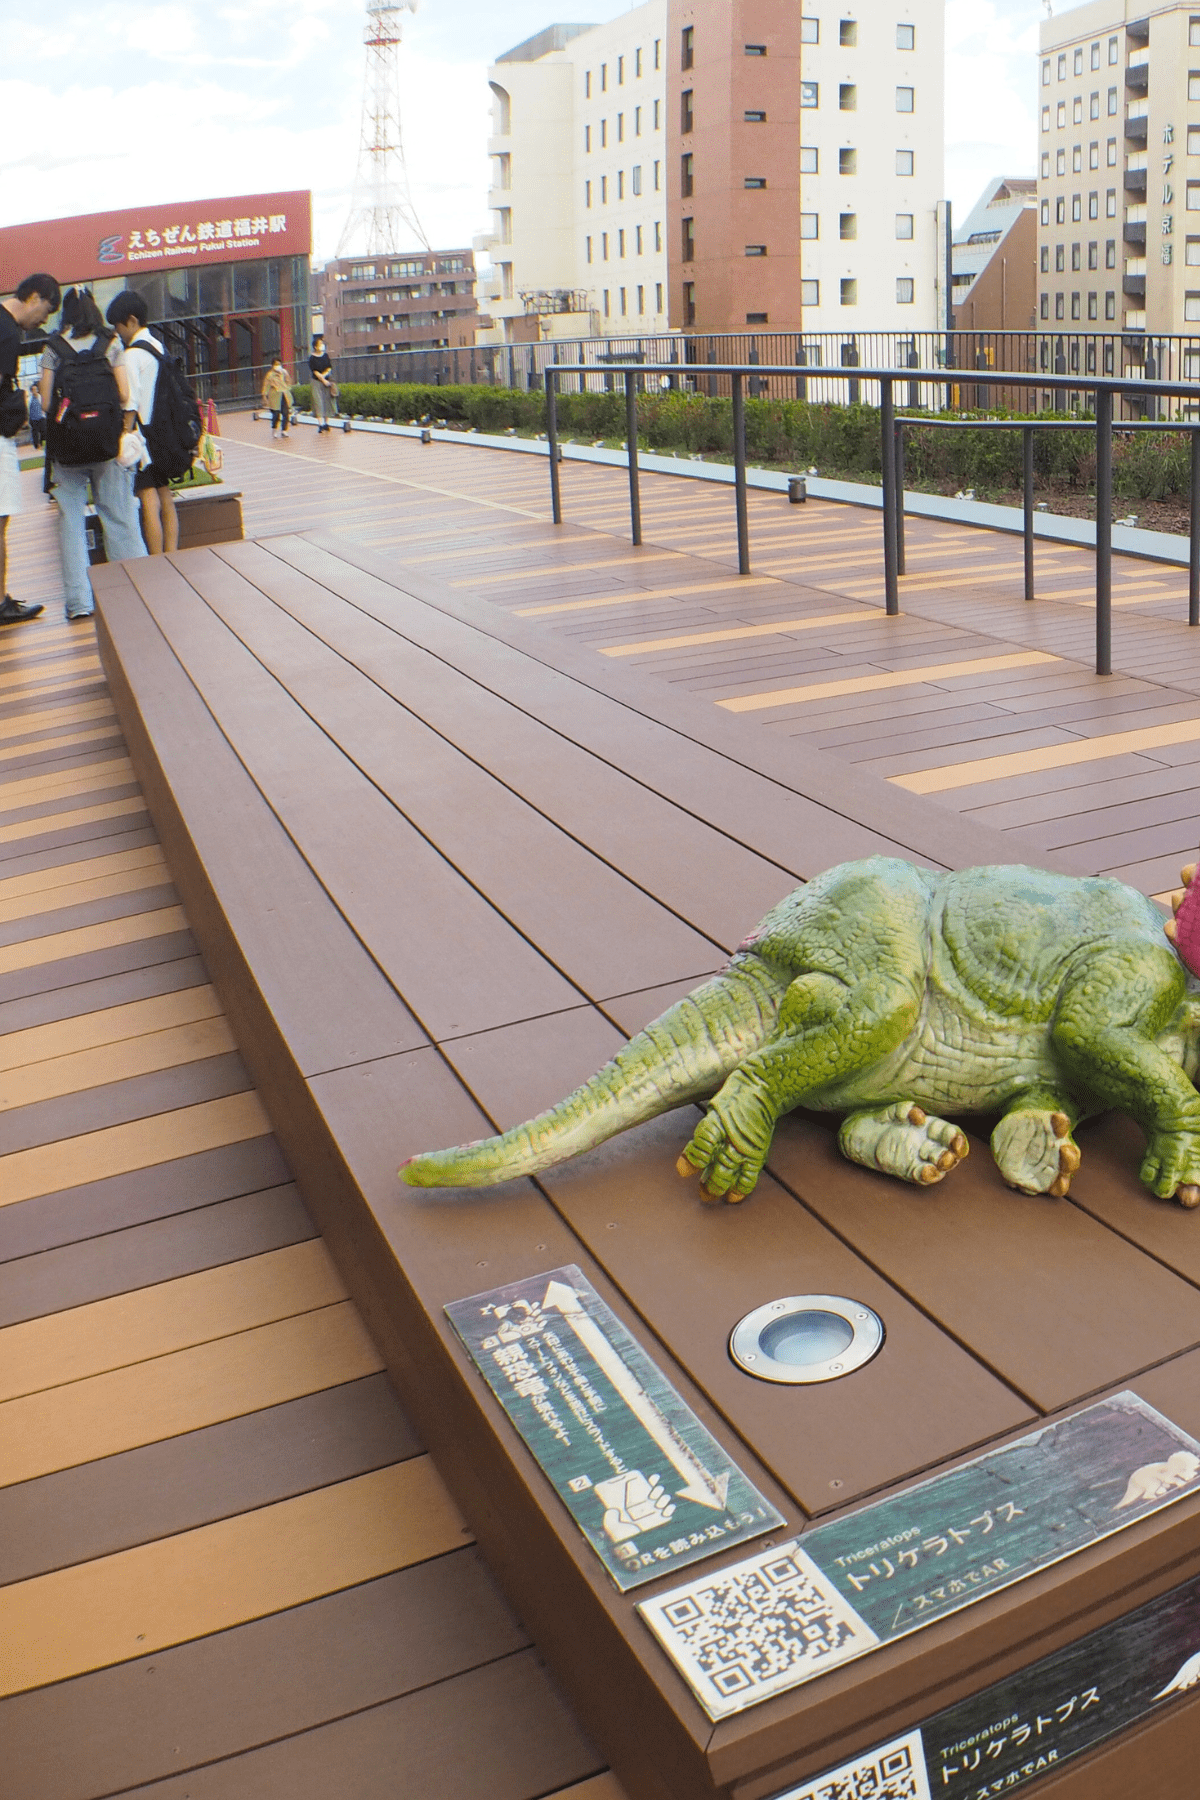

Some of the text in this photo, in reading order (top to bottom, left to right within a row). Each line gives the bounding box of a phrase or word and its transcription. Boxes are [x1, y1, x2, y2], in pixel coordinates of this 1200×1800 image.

[127, 238, 260, 261] Echizen Railway Fukui Station
[128, 214, 287, 249] えちぜん鉄道福井駅
[834, 1525, 922, 1569] Triceratops
[845, 1501, 1026, 1592] トリケラトプス
[912, 1557, 1011, 1610] スマホでAR
[939, 1713, 1019, 1759] Triceratops
[941, 1685, 1101, 1785] トリケラトプス
[976, 1749, 1060, 1800] スマホでAR
